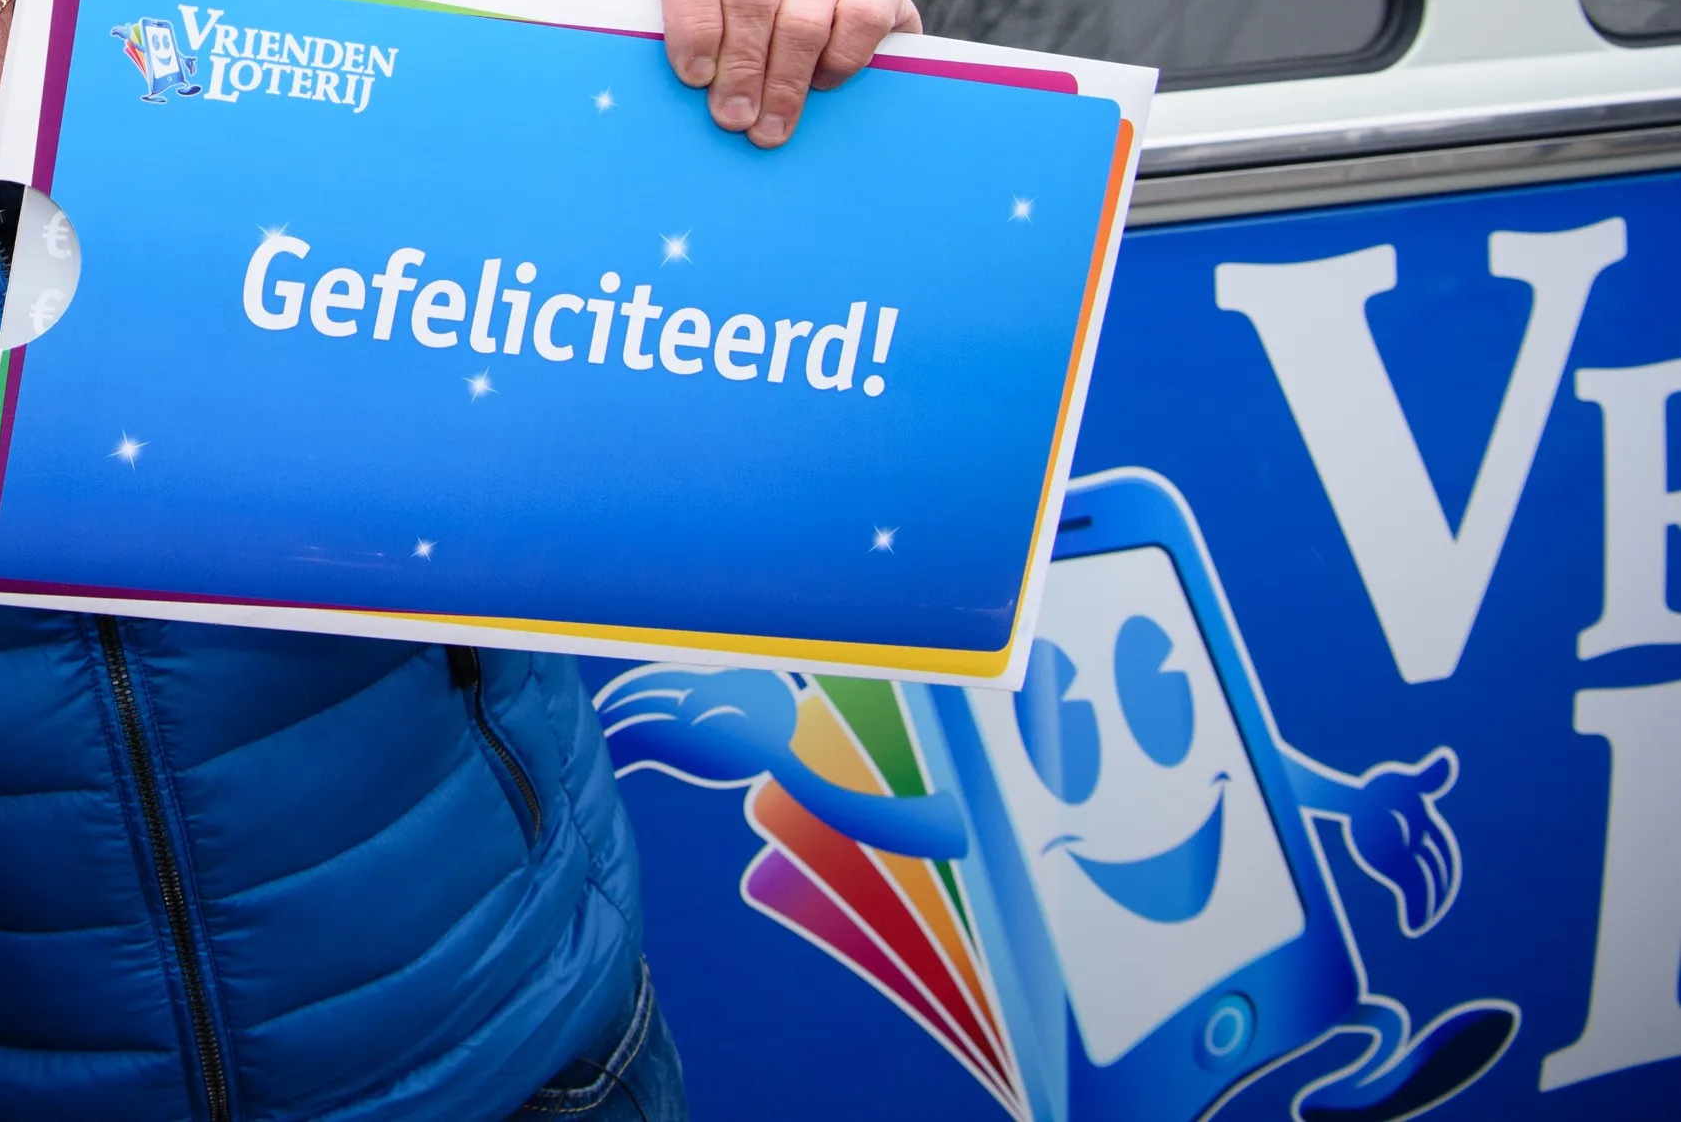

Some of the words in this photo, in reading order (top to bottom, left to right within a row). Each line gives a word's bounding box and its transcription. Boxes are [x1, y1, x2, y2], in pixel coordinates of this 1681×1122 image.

[178, 4, 399, 78] VRIENDEN
[204, 55, 375, 113] LOTERIJ
[242, 235, 899, 398] Gefeliciteerd!
